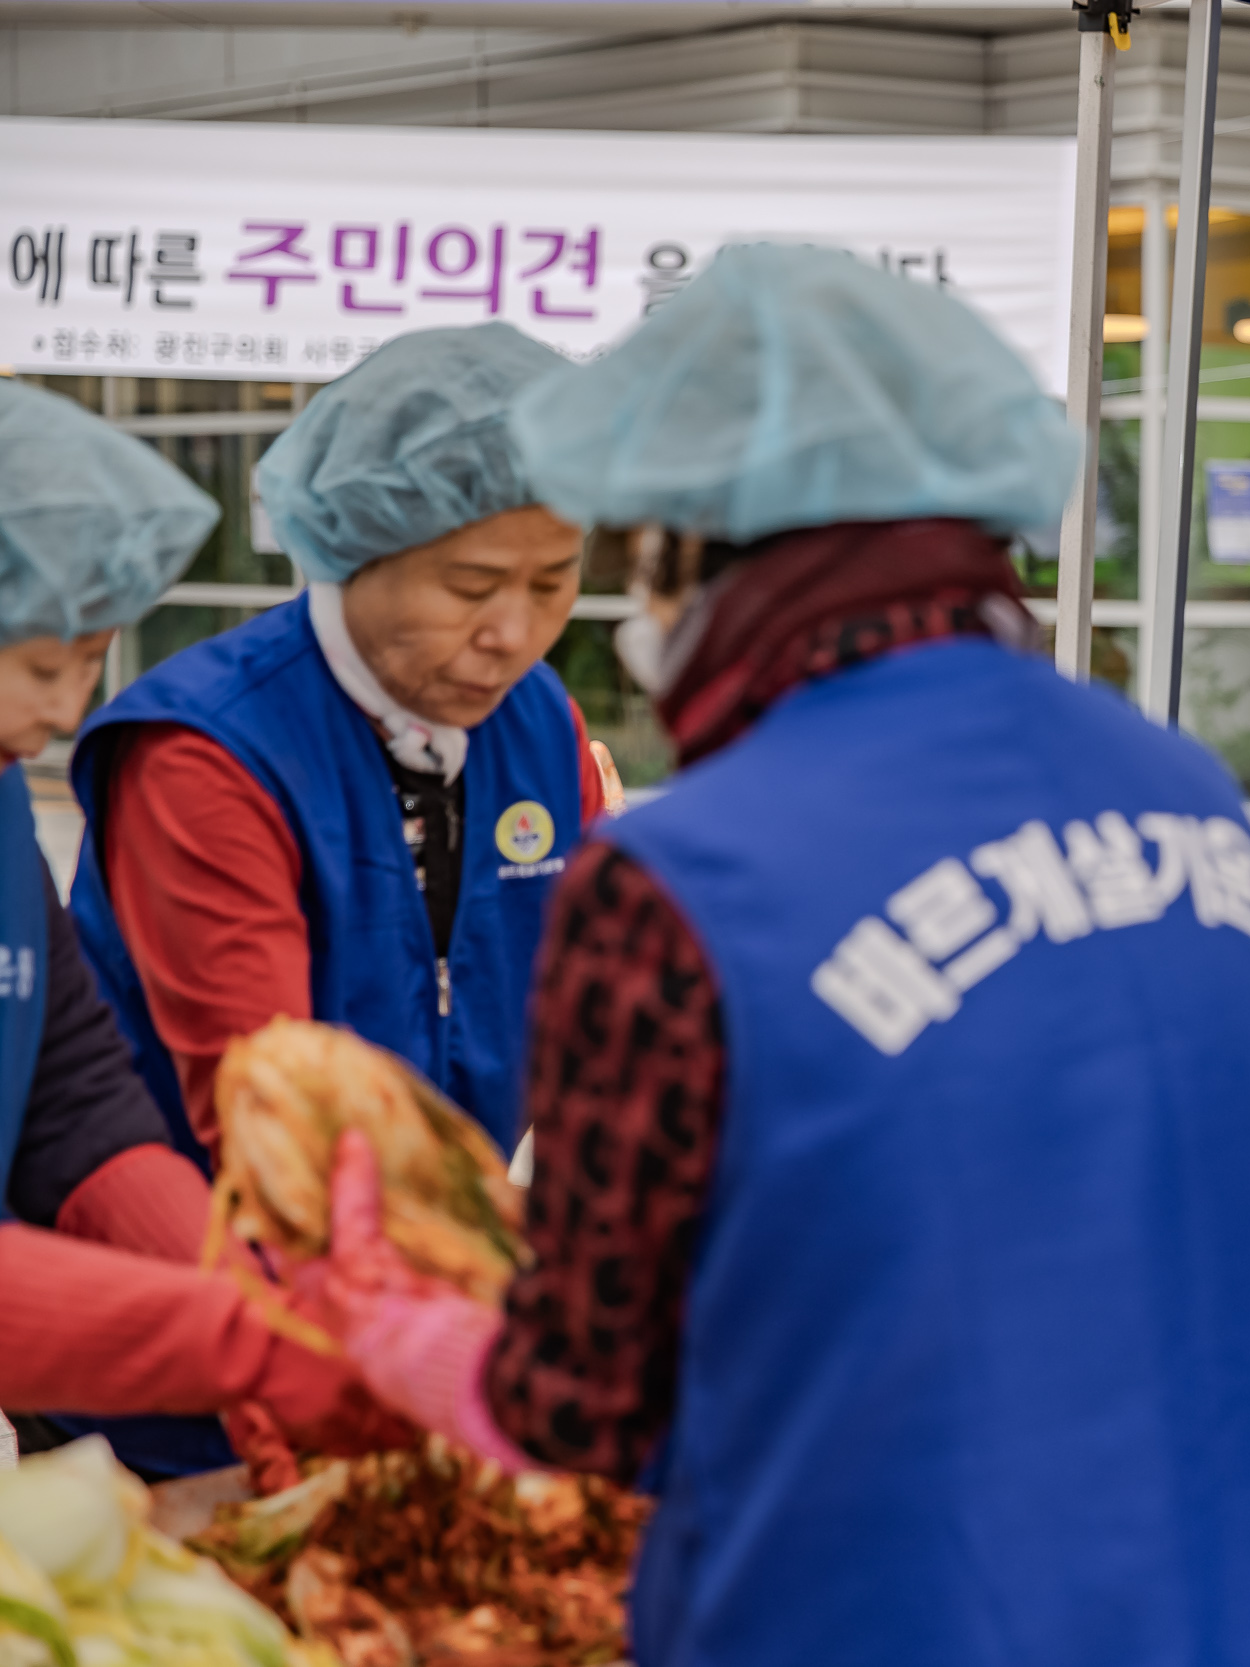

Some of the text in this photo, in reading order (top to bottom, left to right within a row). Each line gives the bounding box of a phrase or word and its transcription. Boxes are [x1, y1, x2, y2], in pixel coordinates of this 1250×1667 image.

[12, 231, 66, 300] 에
[91, 233, 201, 308] 따른
[228, 222, 598, 319] 주민의견
